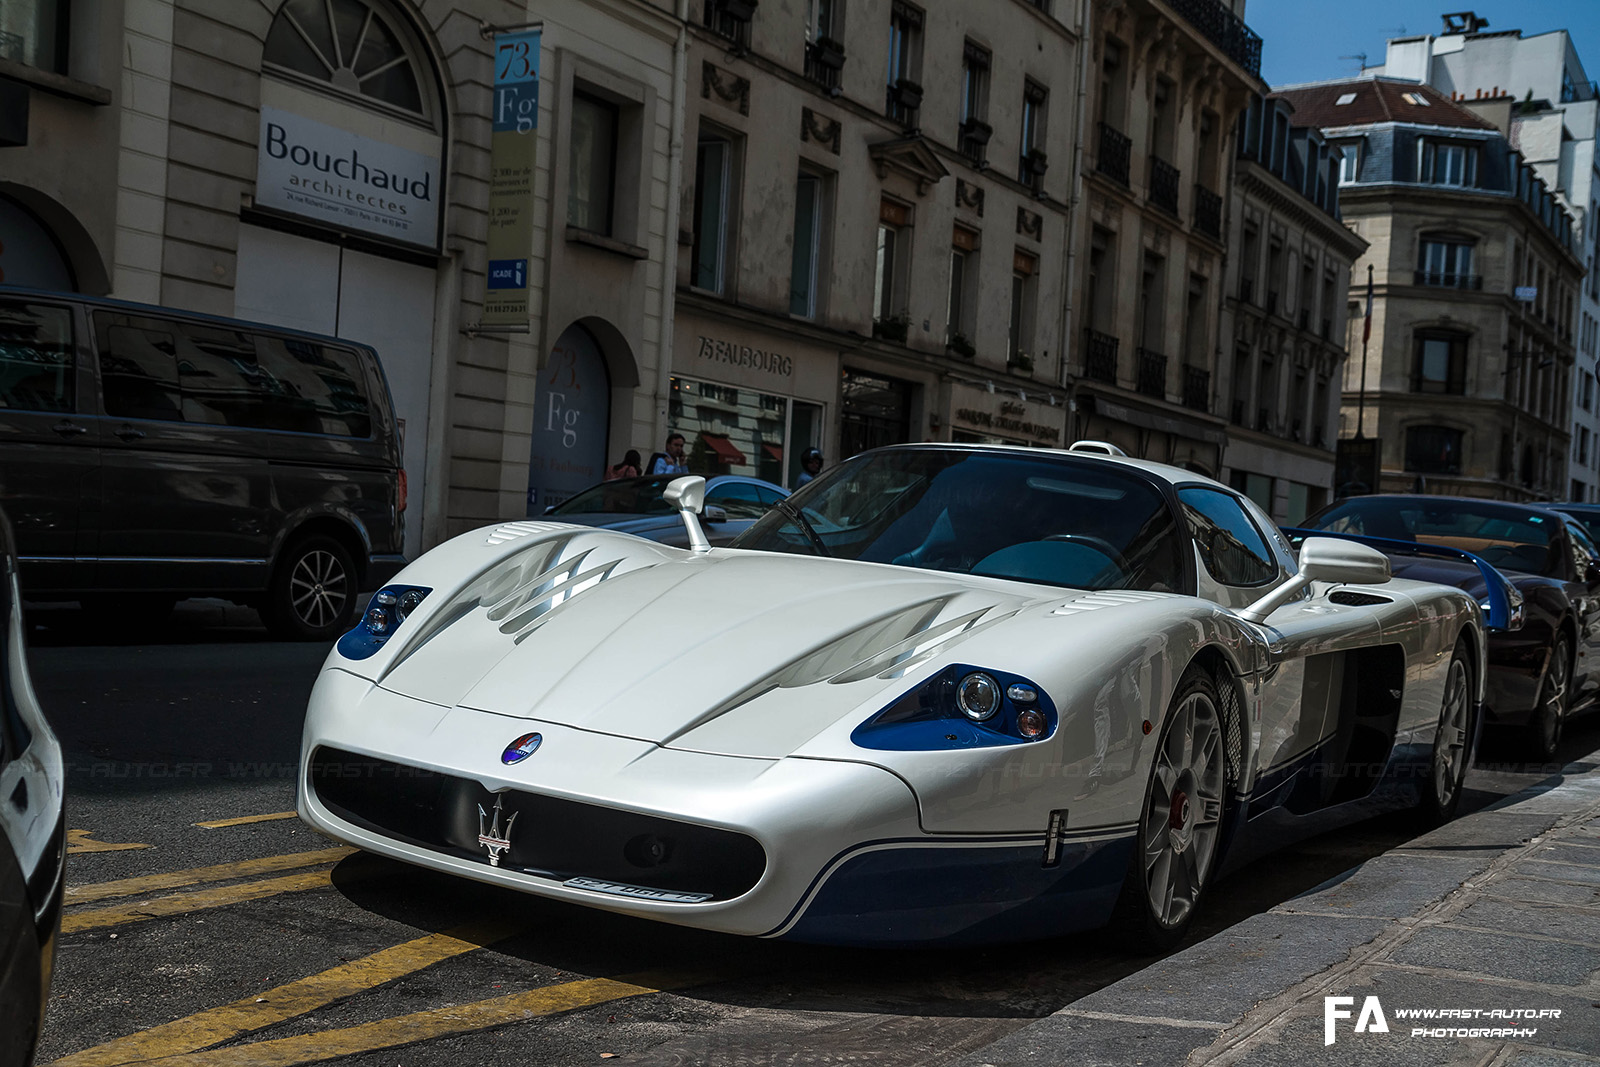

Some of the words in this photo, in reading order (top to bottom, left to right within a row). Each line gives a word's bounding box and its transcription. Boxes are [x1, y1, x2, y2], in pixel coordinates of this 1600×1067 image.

[496, 87, 536, 135] Fg
[266, 122, 431, 201] Bouchaud
[289, 174, 407, 215] architectes
[492, 269, 513, 279] ICADE
[698, 335, 714, 359] 75
[715, 340, 792, 377] FAUBOURG
[544, 390, 580, 449] Fg
